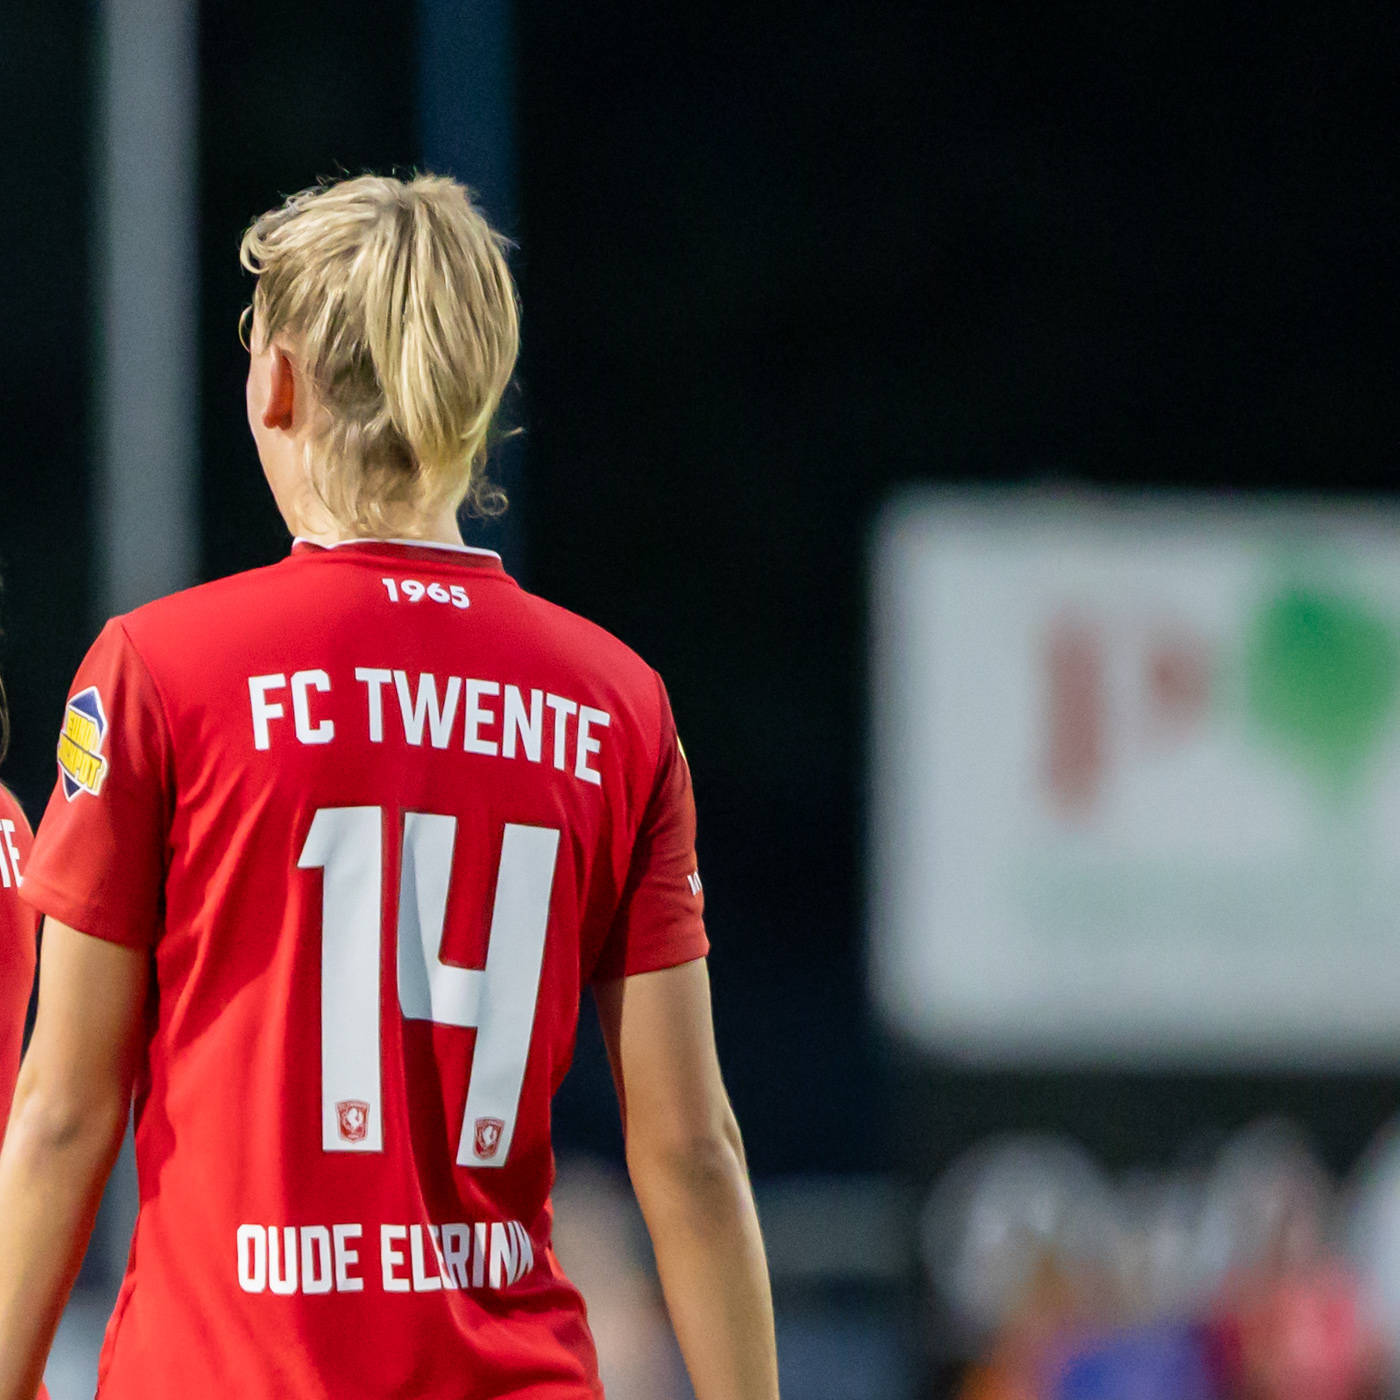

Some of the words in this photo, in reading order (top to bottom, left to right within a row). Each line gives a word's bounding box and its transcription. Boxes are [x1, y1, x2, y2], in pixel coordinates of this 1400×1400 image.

[382, 578, 470, 609] 1965
[248, 669, 334, 750] FC
[355, 667, 611, 786] TWENTE
[297, 805, 560, 1168] 14
[237, 1223, 364, 1295] OUDE
